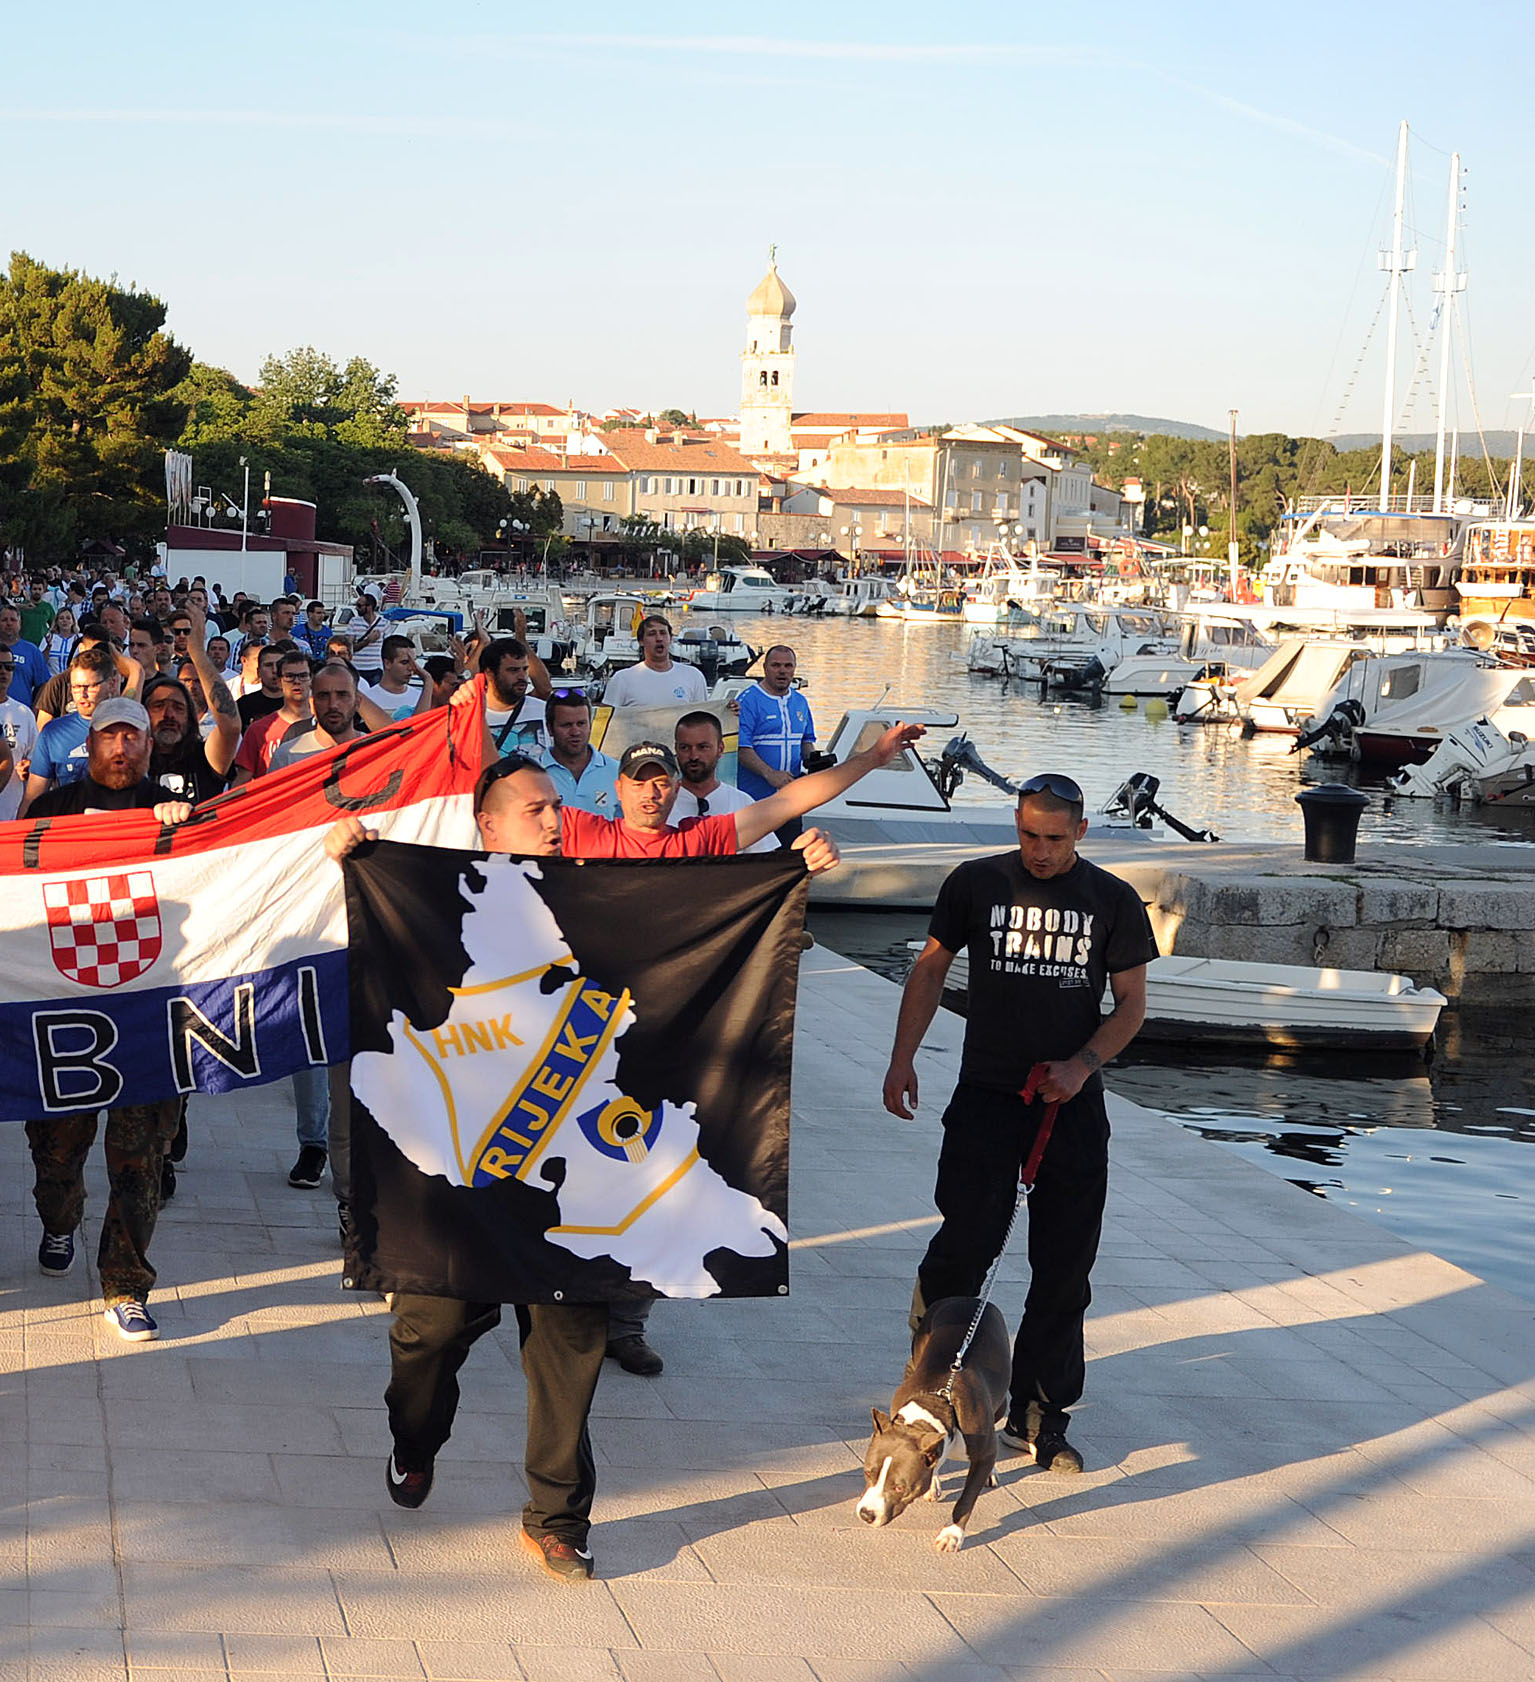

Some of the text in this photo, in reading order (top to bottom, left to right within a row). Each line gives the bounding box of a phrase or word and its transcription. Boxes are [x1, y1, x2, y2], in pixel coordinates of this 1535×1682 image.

[1472, 725, 1494, 749] SUZUKI
[990, 904, 1095, 937] NOBODY
[989, 930, 1093, 966] TRAINS
[990, 959, 1002, 972] TO
[1005, 961, 1036, 976] MAKE
[431, 1012, 525, 1060] HNK
[478, 986, 618, 1181] RIJEKA
